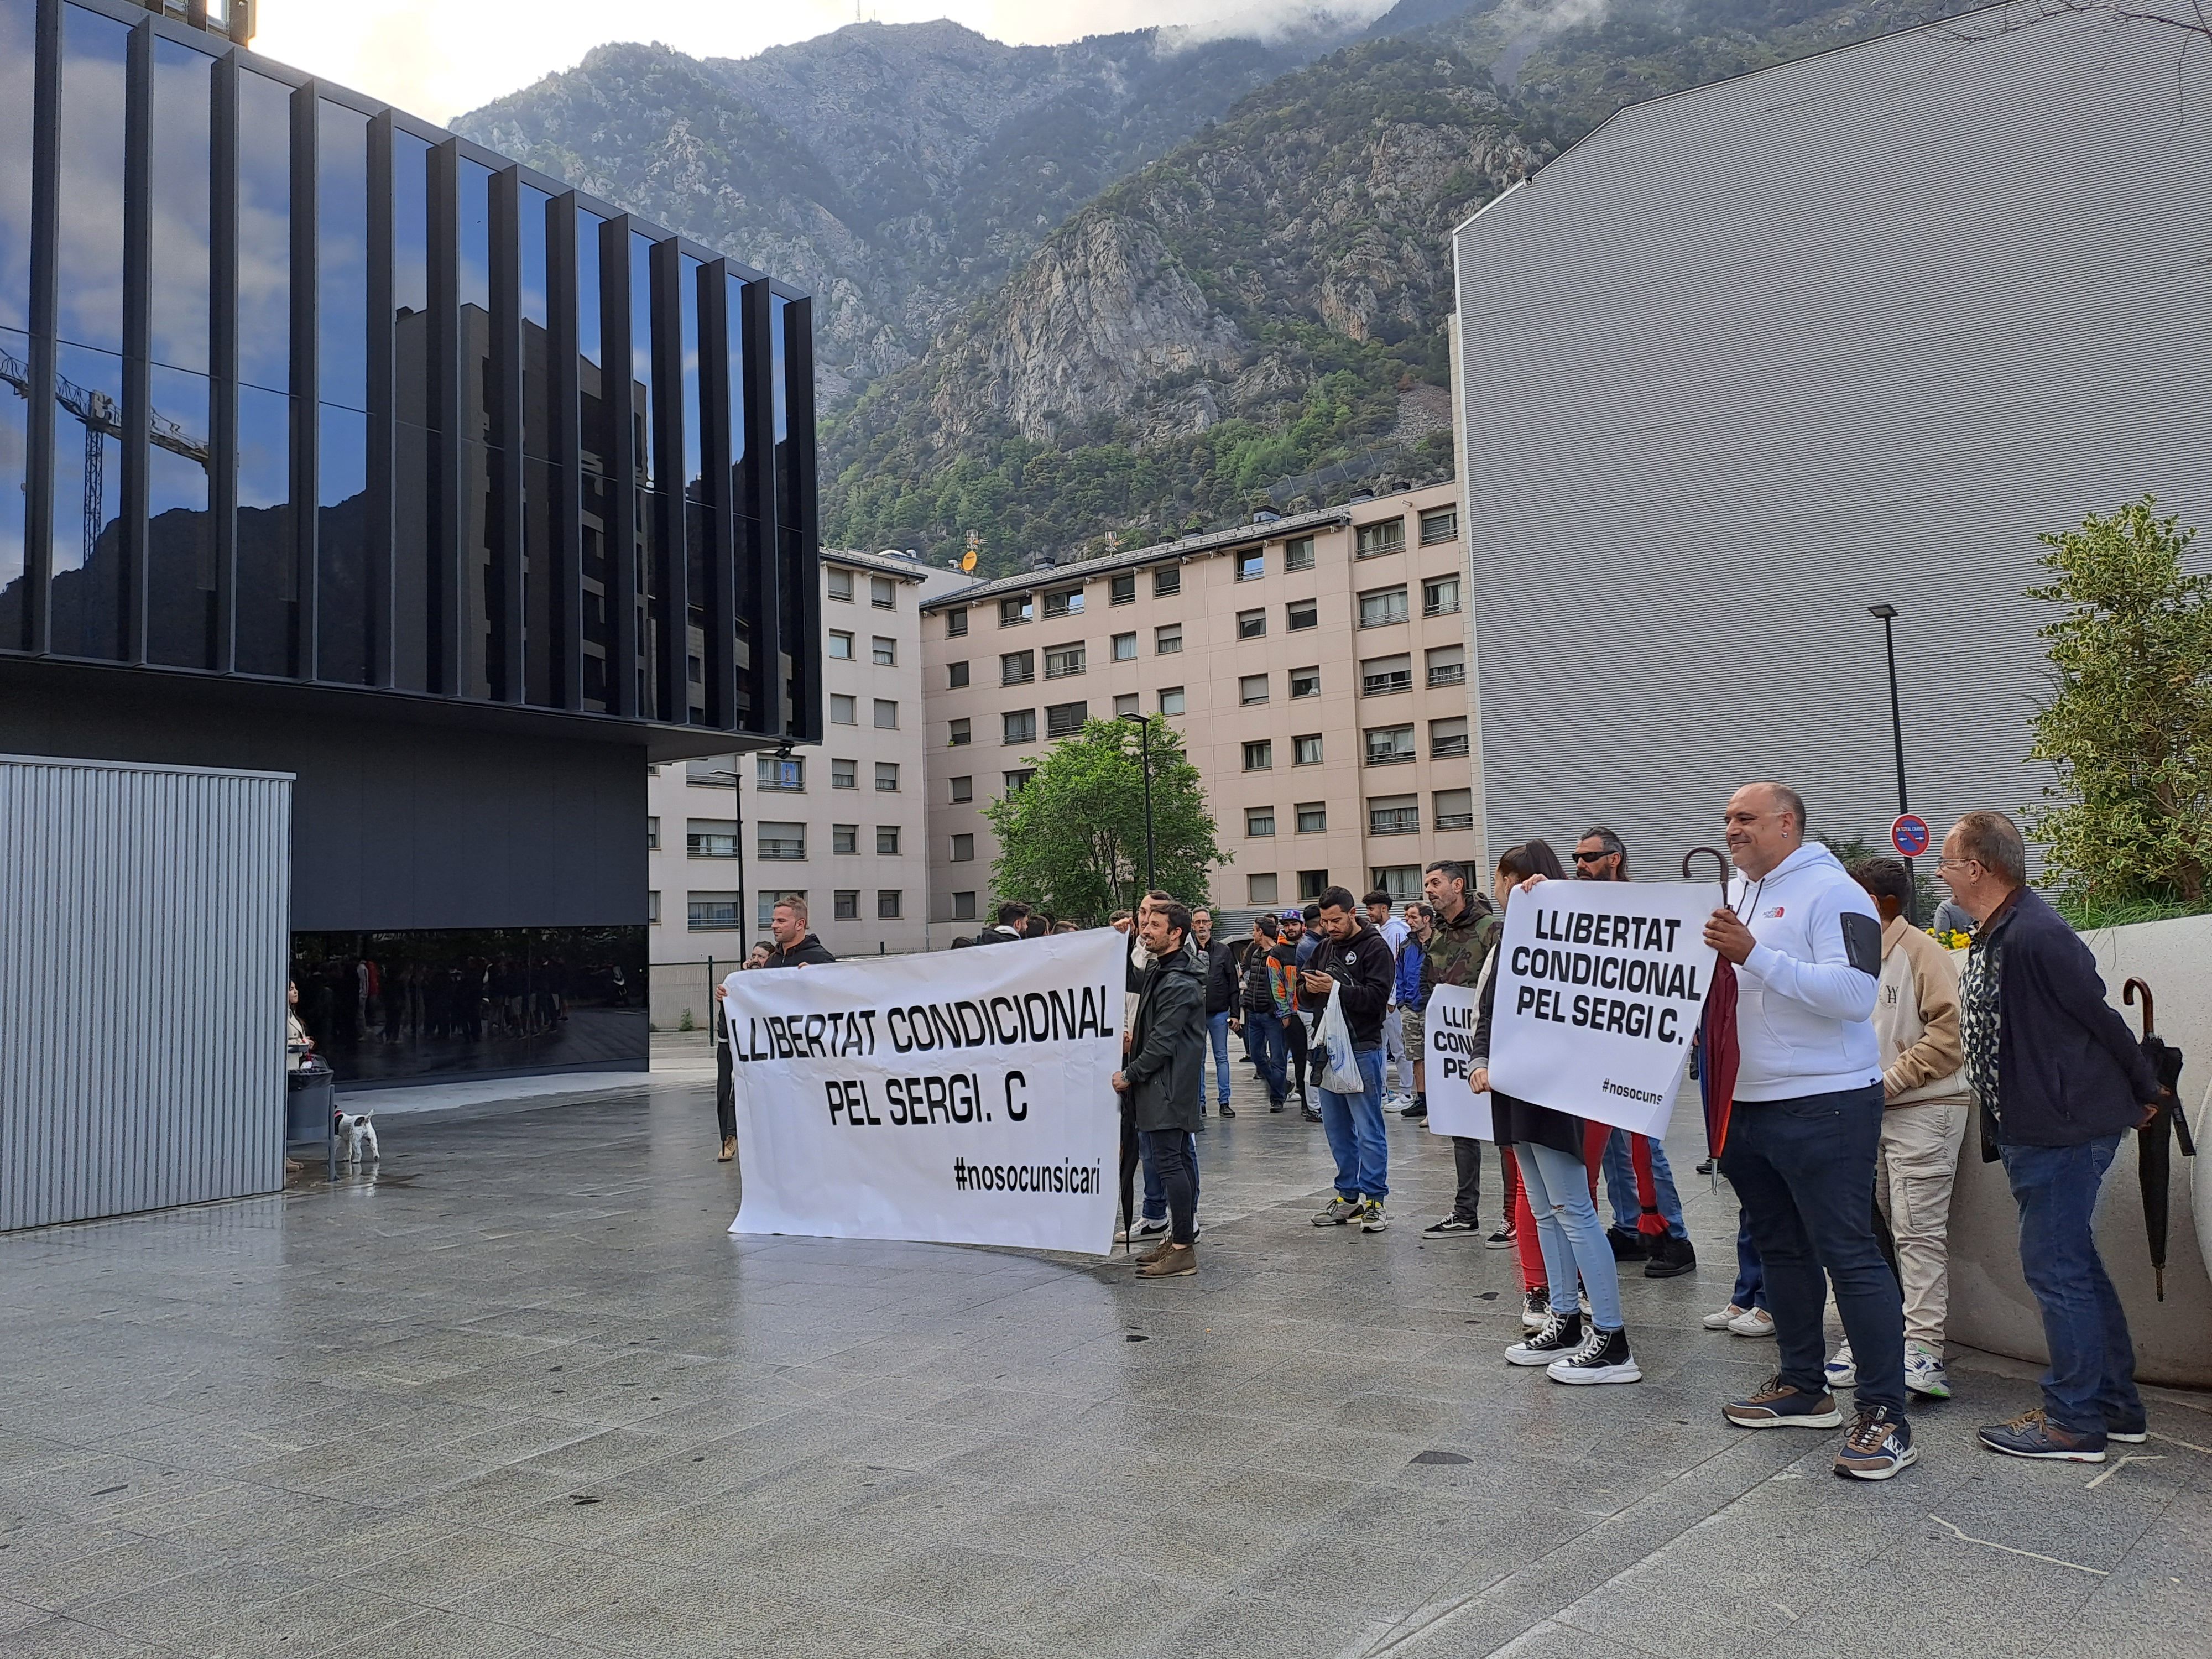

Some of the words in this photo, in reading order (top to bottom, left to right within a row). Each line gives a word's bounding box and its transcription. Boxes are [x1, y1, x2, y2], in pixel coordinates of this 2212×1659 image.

[1536, 909, 1681, 952] LLIBERTAT
[1511, 946, 1701, 1001] CONDICIONAL
[731, 1010, 876, 1062] LLIBERTAT
[887, 985, 1113, 1053] CONDICIONAL
[1516, 985, 1566, 1023] PEL
[1572, 994, 1653, 1039] SERGI
[1658, 1008, 1683, 1045] C.
[1443, 1058, 1470, 1080] PE
[1602, 1078, 1666, 1105] #nosocuns
[825, 1080, 881, 1126] PEL
[885, 1073, 992, 1126] SERGI.
[1005, 1070, 1027, 1121] C
[954, 1157, 1100, 1194] #nosocunsicari
